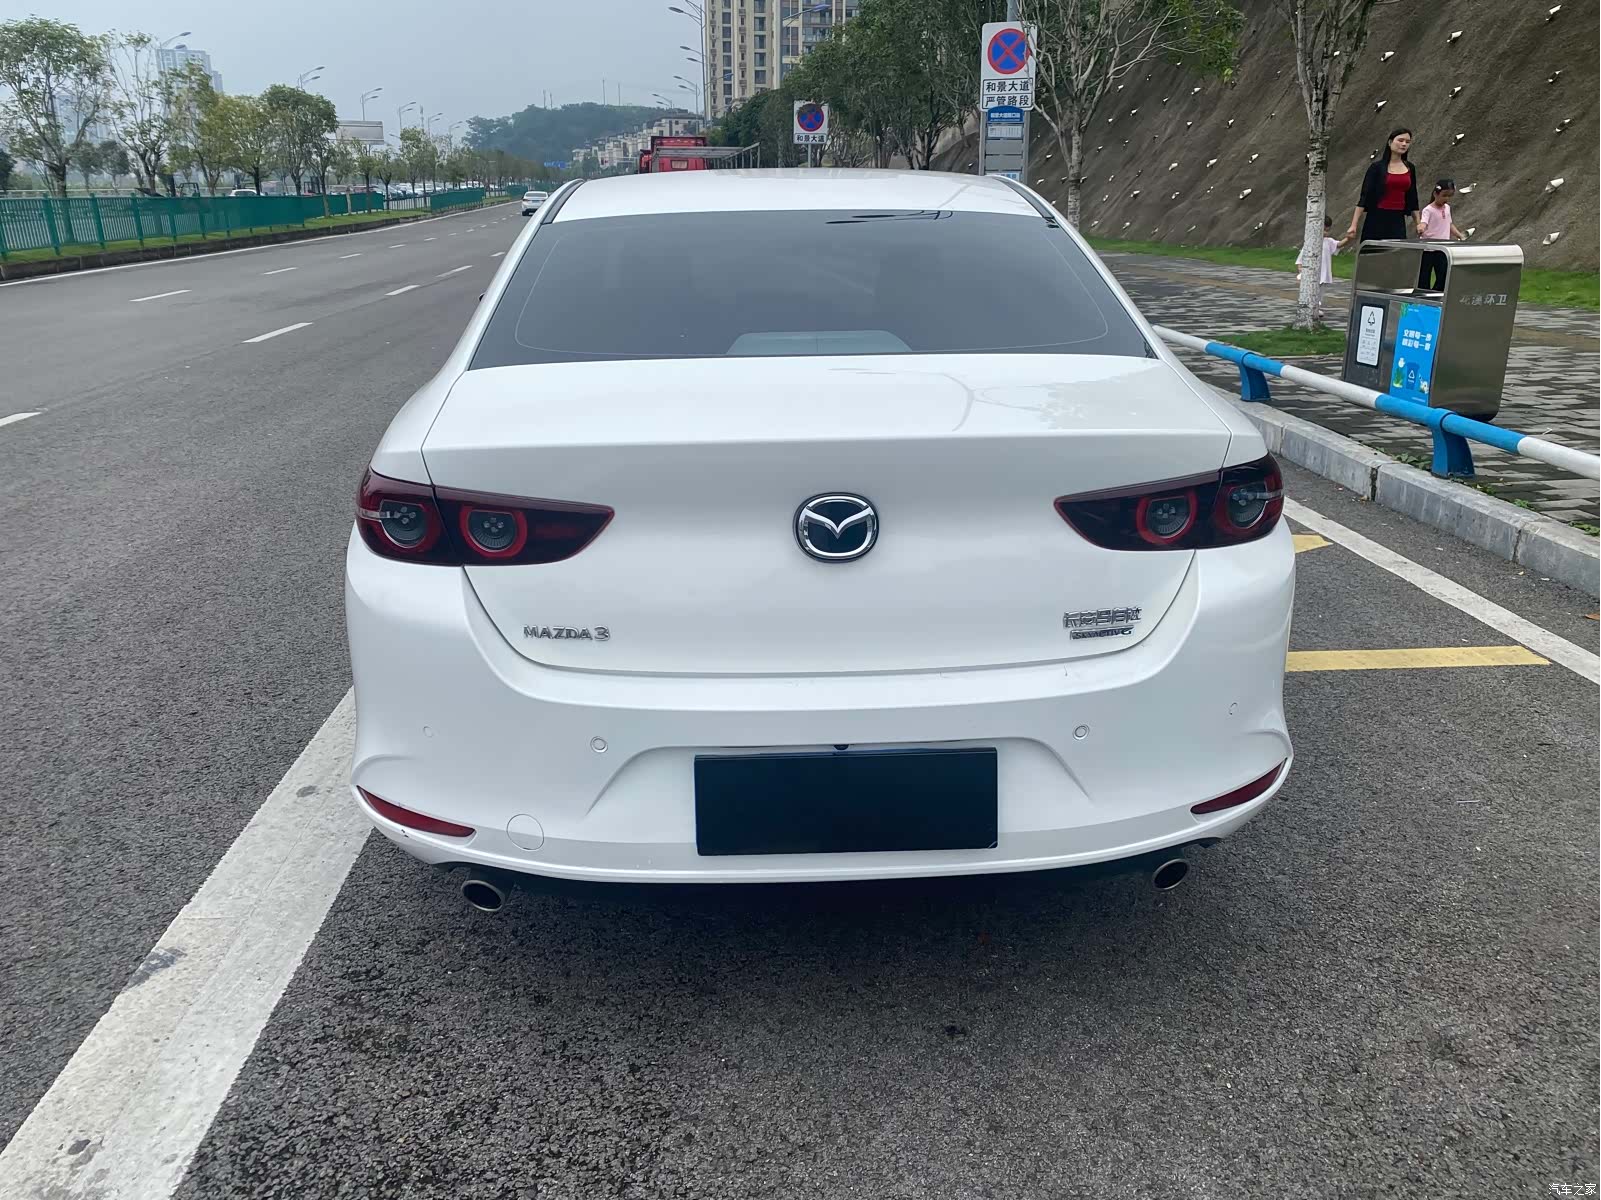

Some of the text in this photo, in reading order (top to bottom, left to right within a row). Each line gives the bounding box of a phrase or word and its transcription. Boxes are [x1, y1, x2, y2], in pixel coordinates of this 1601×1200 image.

[986, 81, 1030, 92] 和景大道
[985, 95, 1029, 107] 严管路段
